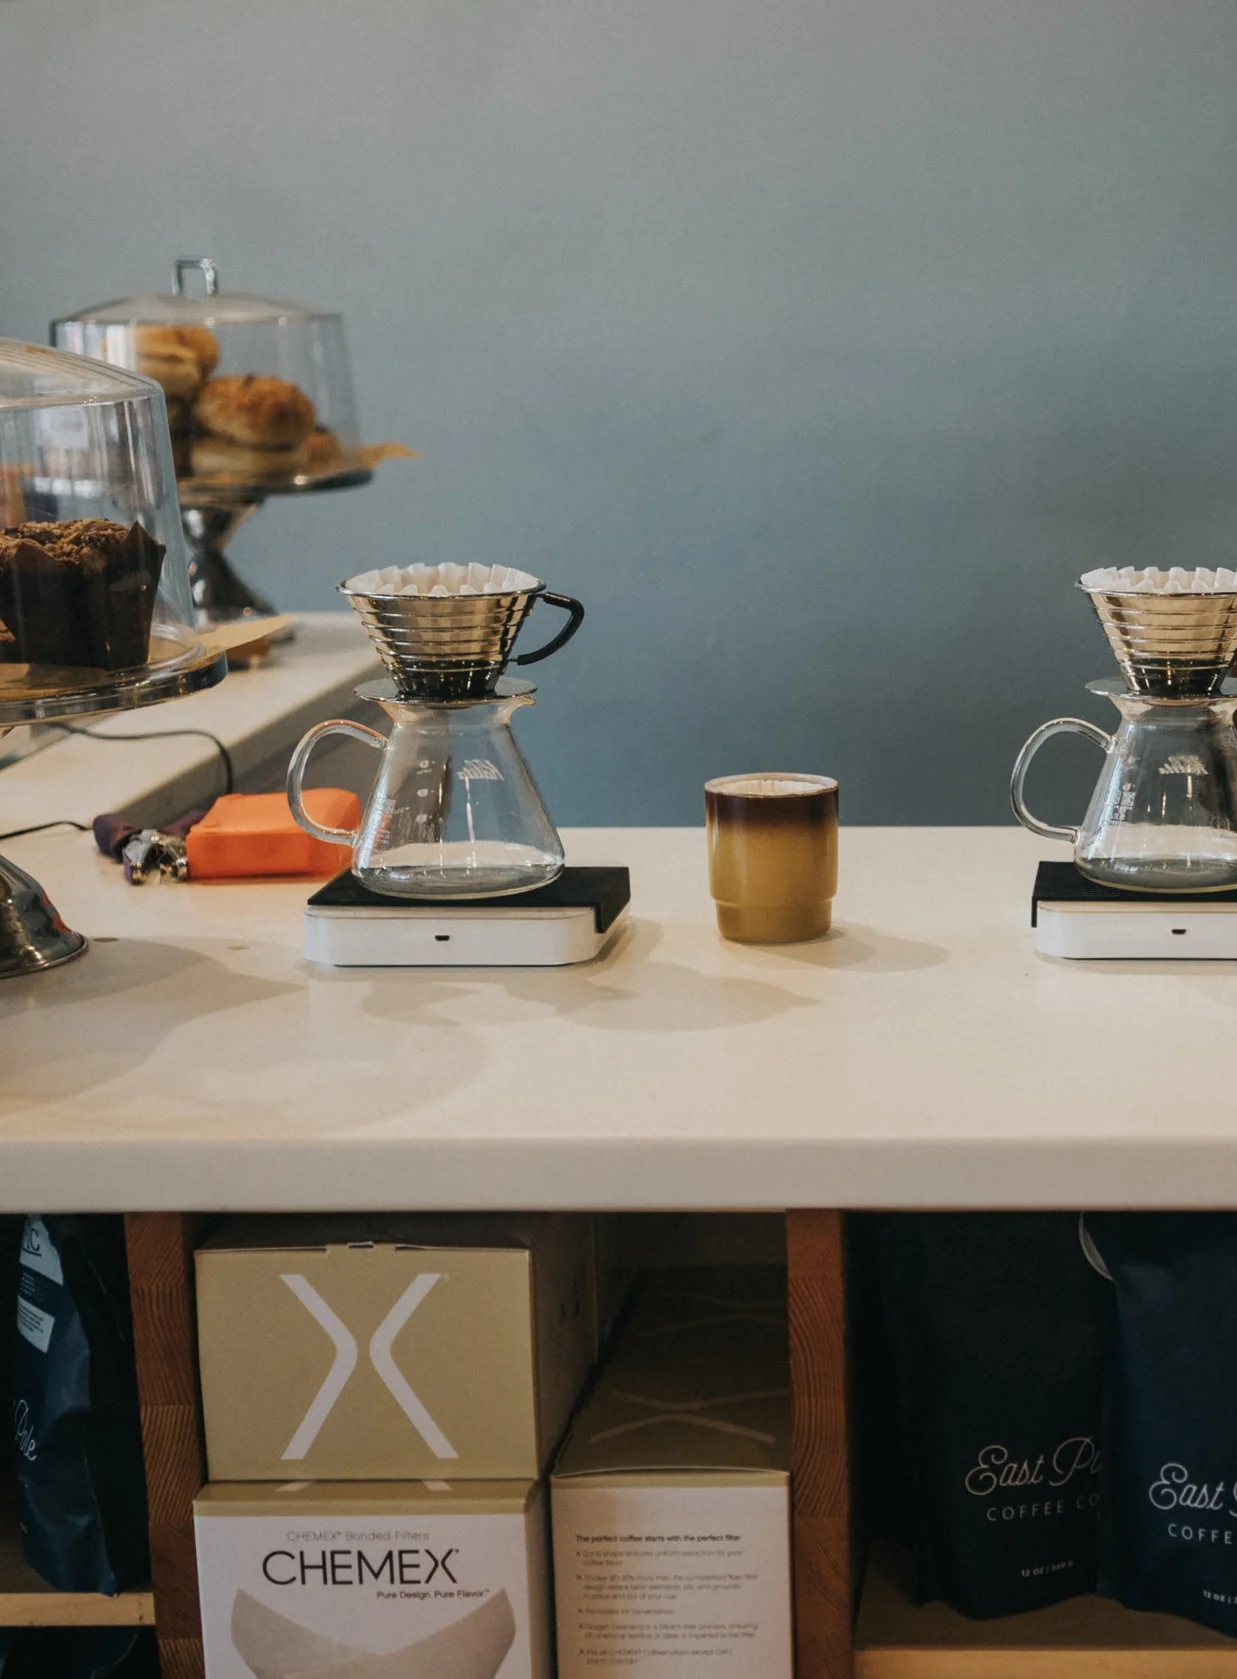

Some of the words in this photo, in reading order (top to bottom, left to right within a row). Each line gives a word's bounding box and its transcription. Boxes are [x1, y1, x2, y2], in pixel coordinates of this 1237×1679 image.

[965, 1444, 1044, 1496] East
[1049, 1436, 1101, 1486] Po
[1149, 1463, 1225, 1510] East
[986, 1499, 1065, 1522] COFFEE
[345, 1530, 390, 1541] Bonded
[394, 1529, 430, 1541] Filters
[576, 1534, 590, 1542] The
[591, 1534, 618, 1543] perfect
[619, 1534, 643, 1542] coffee
[666, 1534, 681, 1542] with
[682, 1534, 695, 1542] the
[696, 1534, 723, 1543] perfect
[725, 1533, 741, 1541] filter
[376, 1591, 397, 1600] Pure
[434, 1590, 455, 1599] Pure
